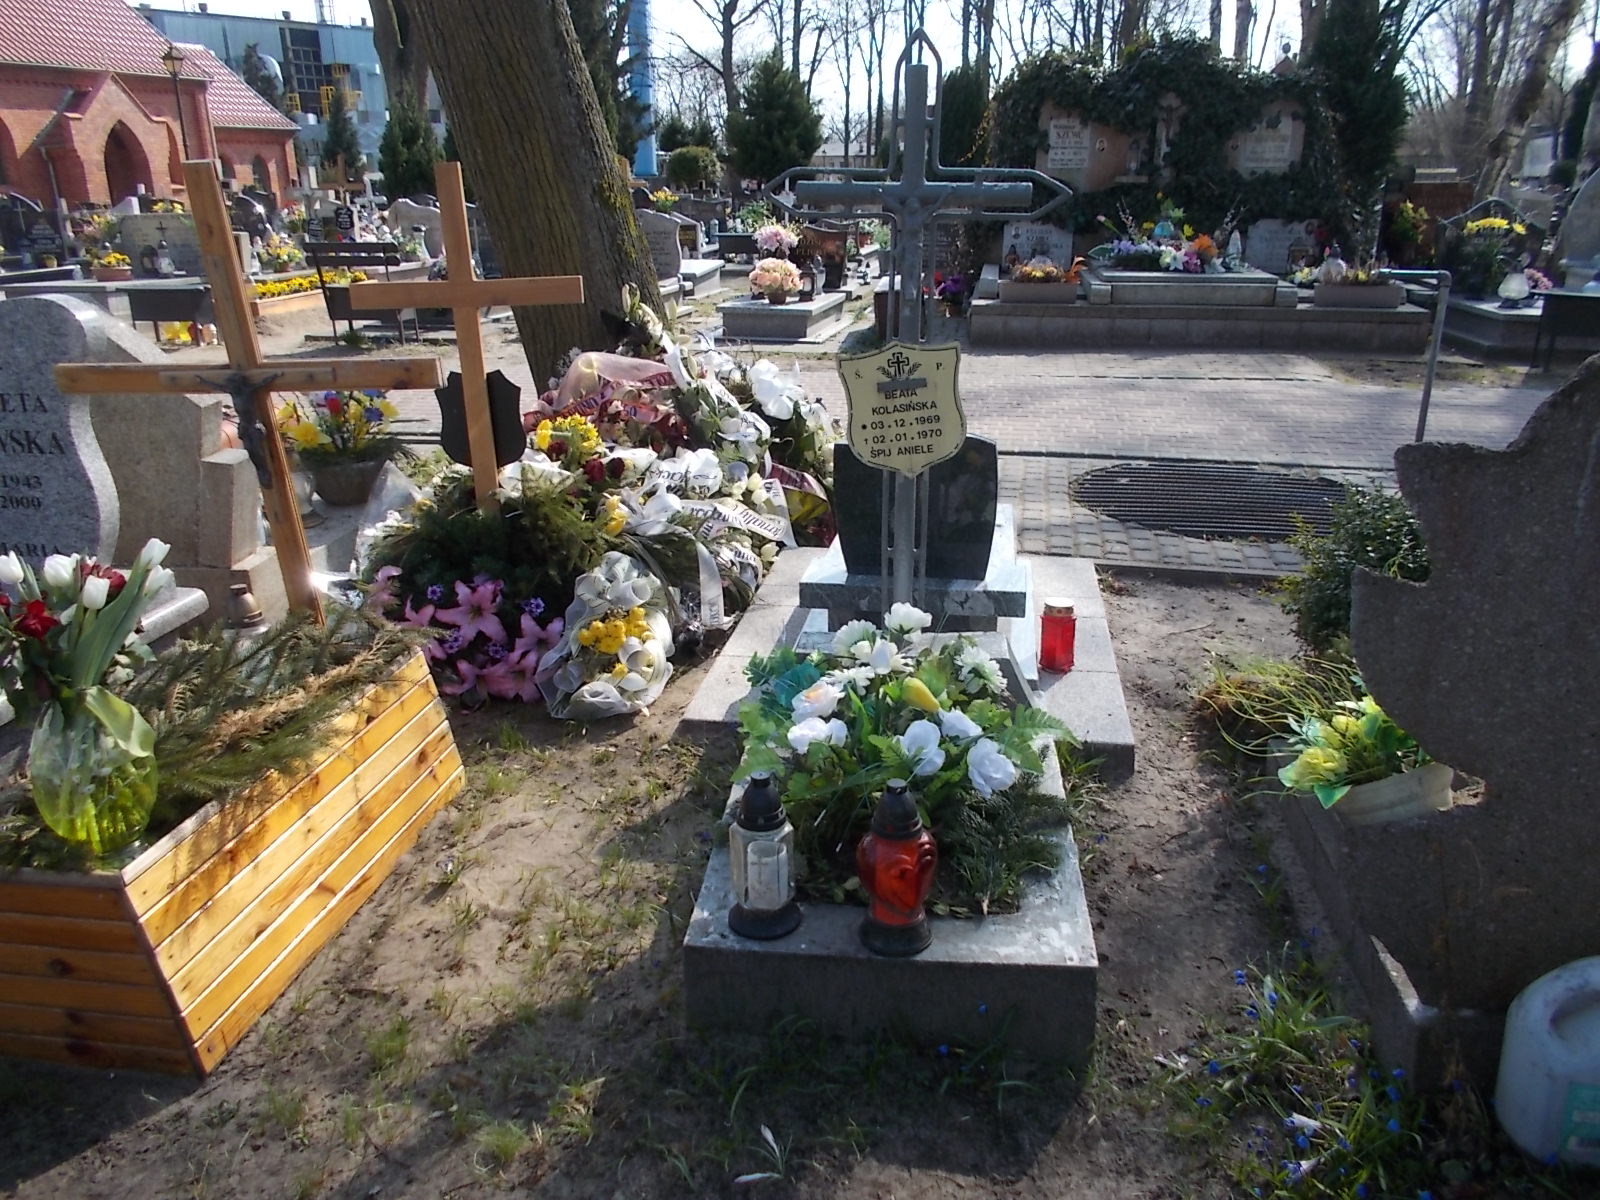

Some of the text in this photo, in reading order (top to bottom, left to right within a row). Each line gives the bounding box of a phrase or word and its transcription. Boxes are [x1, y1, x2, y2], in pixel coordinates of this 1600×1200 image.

[884, 389, 918, 400] BEATA
[871, 400, 938, 416] KOLASIŃSKA
[870, 444, 934, 459] ŚPIJ ANIELE
